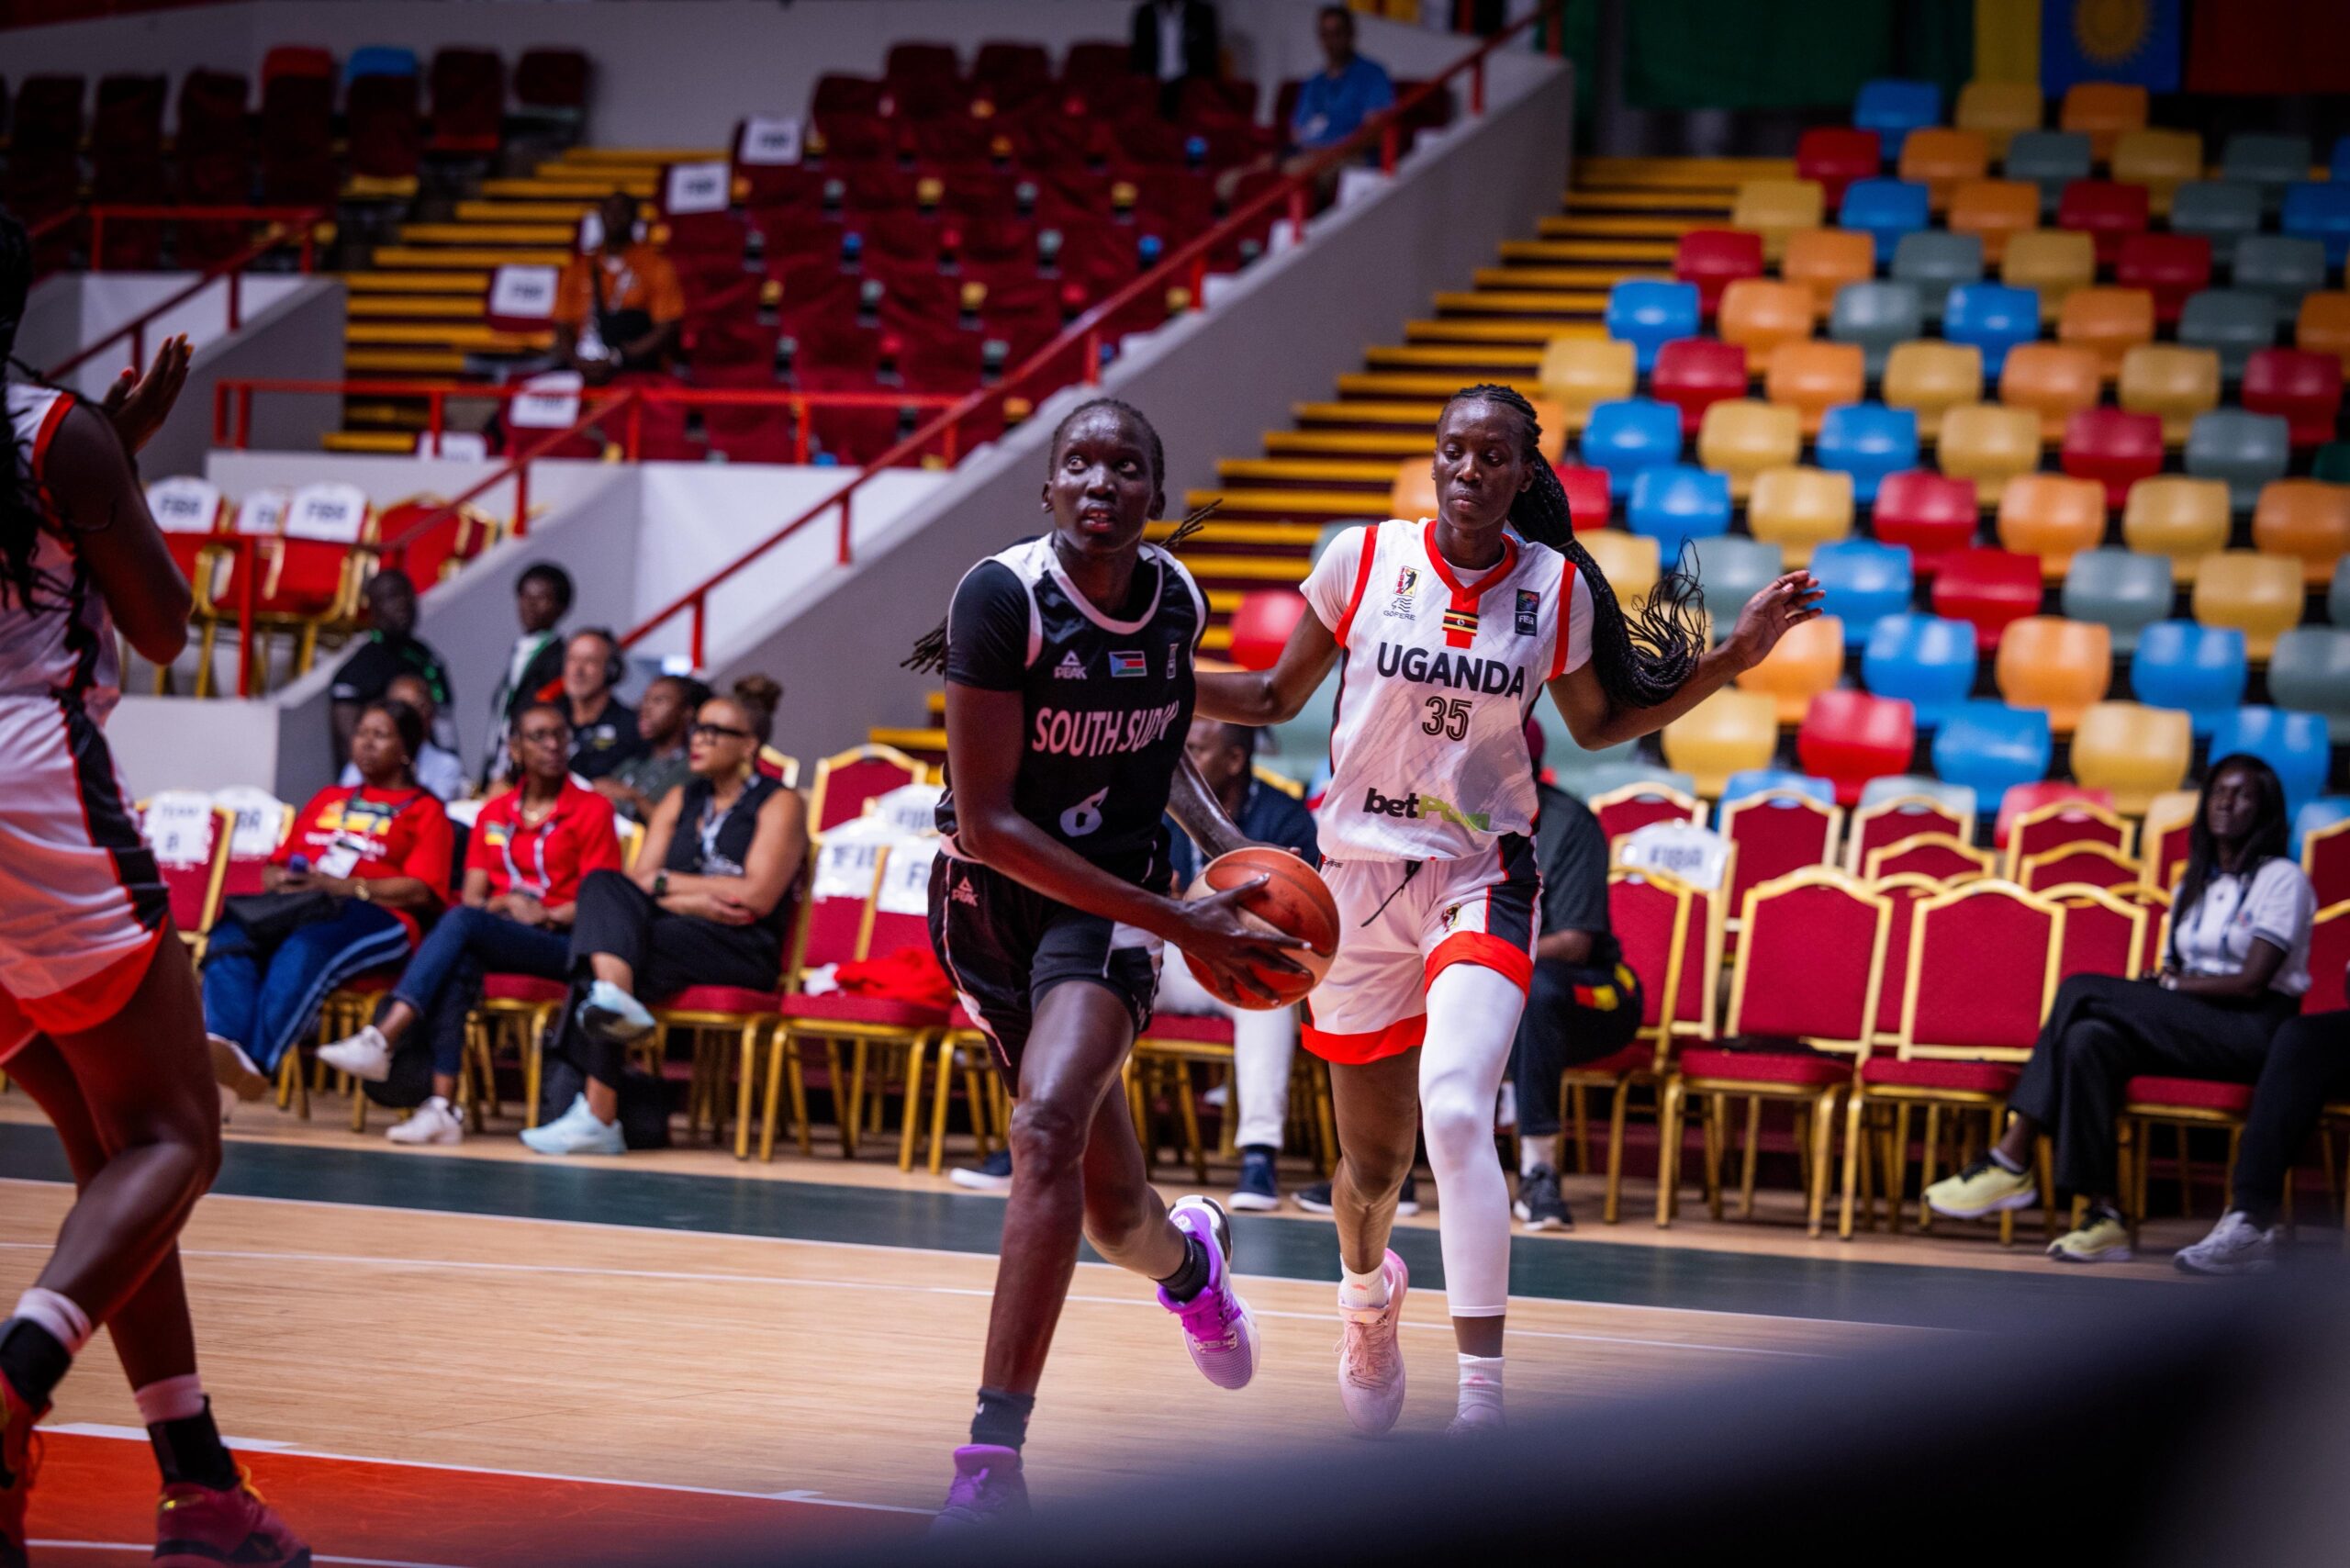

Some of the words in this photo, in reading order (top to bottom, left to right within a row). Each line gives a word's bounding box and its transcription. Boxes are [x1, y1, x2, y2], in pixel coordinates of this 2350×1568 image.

[1054, 666, 1088, 679] PEAK
[1377, 642, 1525, 700] UGANDA
[1032, 707, 1124, 757] SOUTH
[1422, 695, 1472, 742] 35
